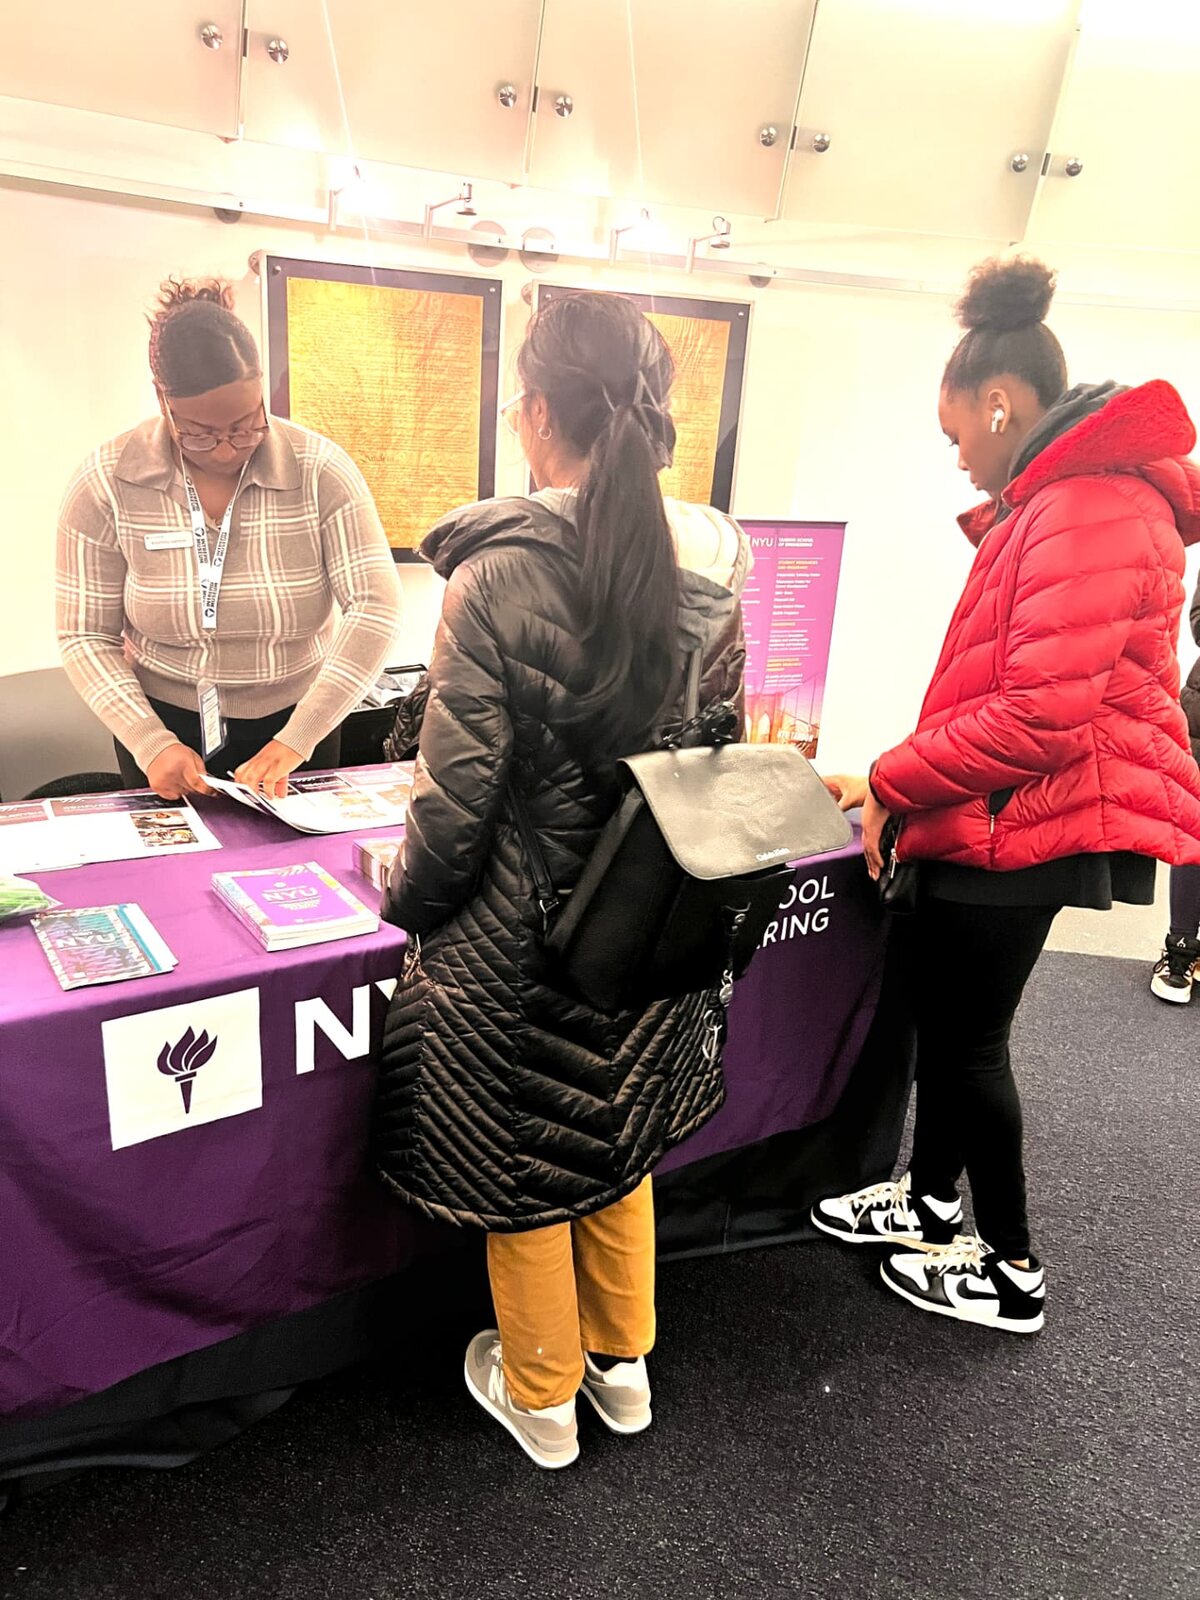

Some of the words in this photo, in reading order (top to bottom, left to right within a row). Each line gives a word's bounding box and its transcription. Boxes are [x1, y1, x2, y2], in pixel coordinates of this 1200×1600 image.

[196, 538, 204, 564] MUSEUM
[200, 538, 209, 564] INTREPID
[751, 537, 774, 548] NYU
[261, 887, 319, 902] NYU
[756, 907, 830, 949] RING
[56, 932, 116, 948] NYU
